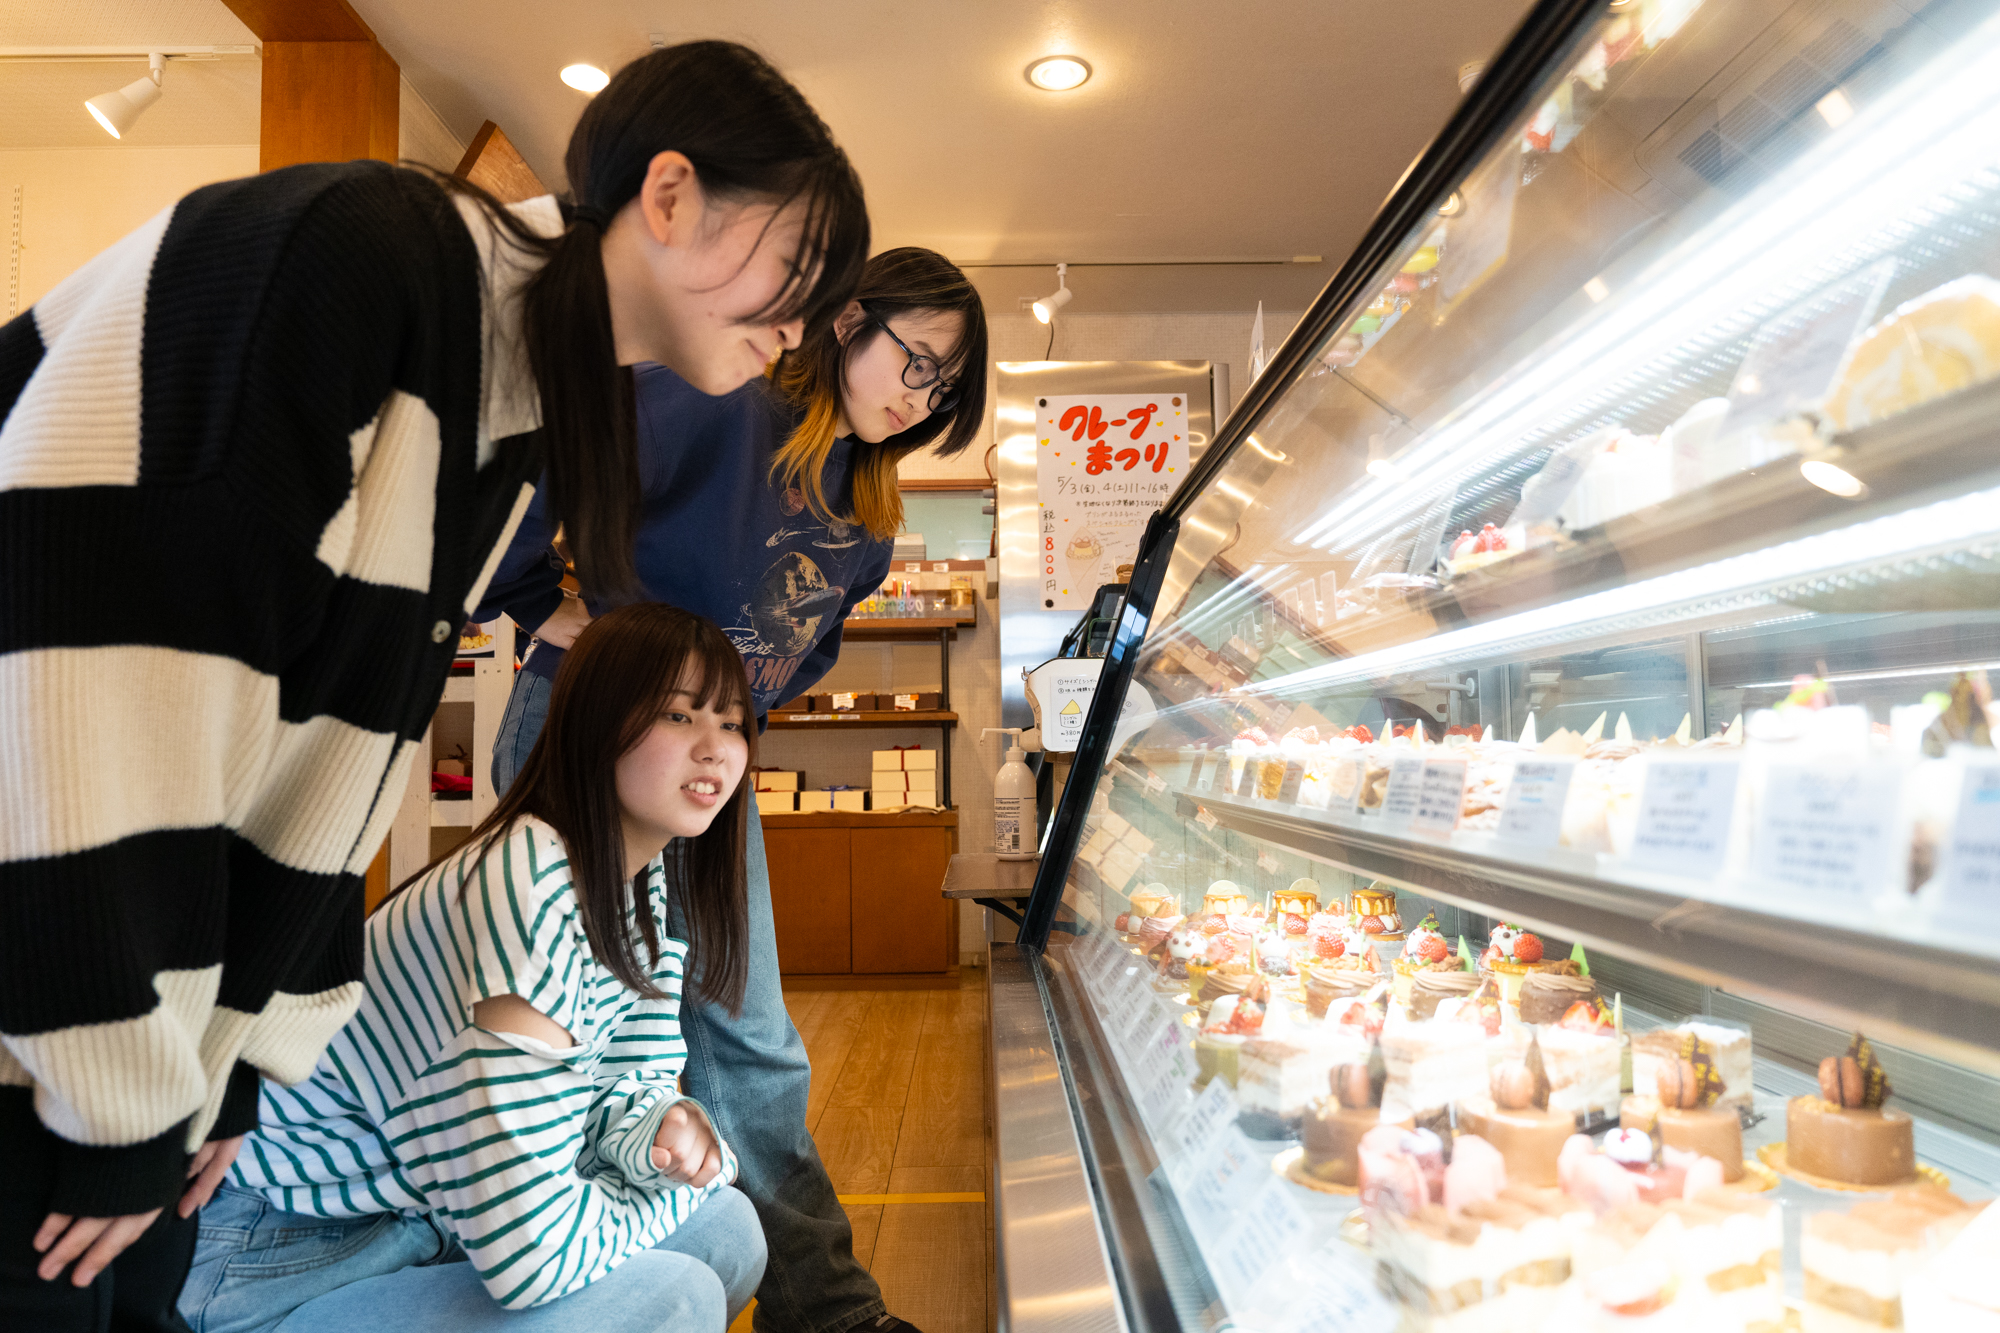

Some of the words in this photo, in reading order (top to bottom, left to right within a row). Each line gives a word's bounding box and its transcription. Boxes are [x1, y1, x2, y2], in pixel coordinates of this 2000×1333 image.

[1059, 403, 1158, 441] クレープ
[1086, 440, 1169, 475] まつり
[869, 600, 876, 613] 5
[898, 600, 905, 612] 8
